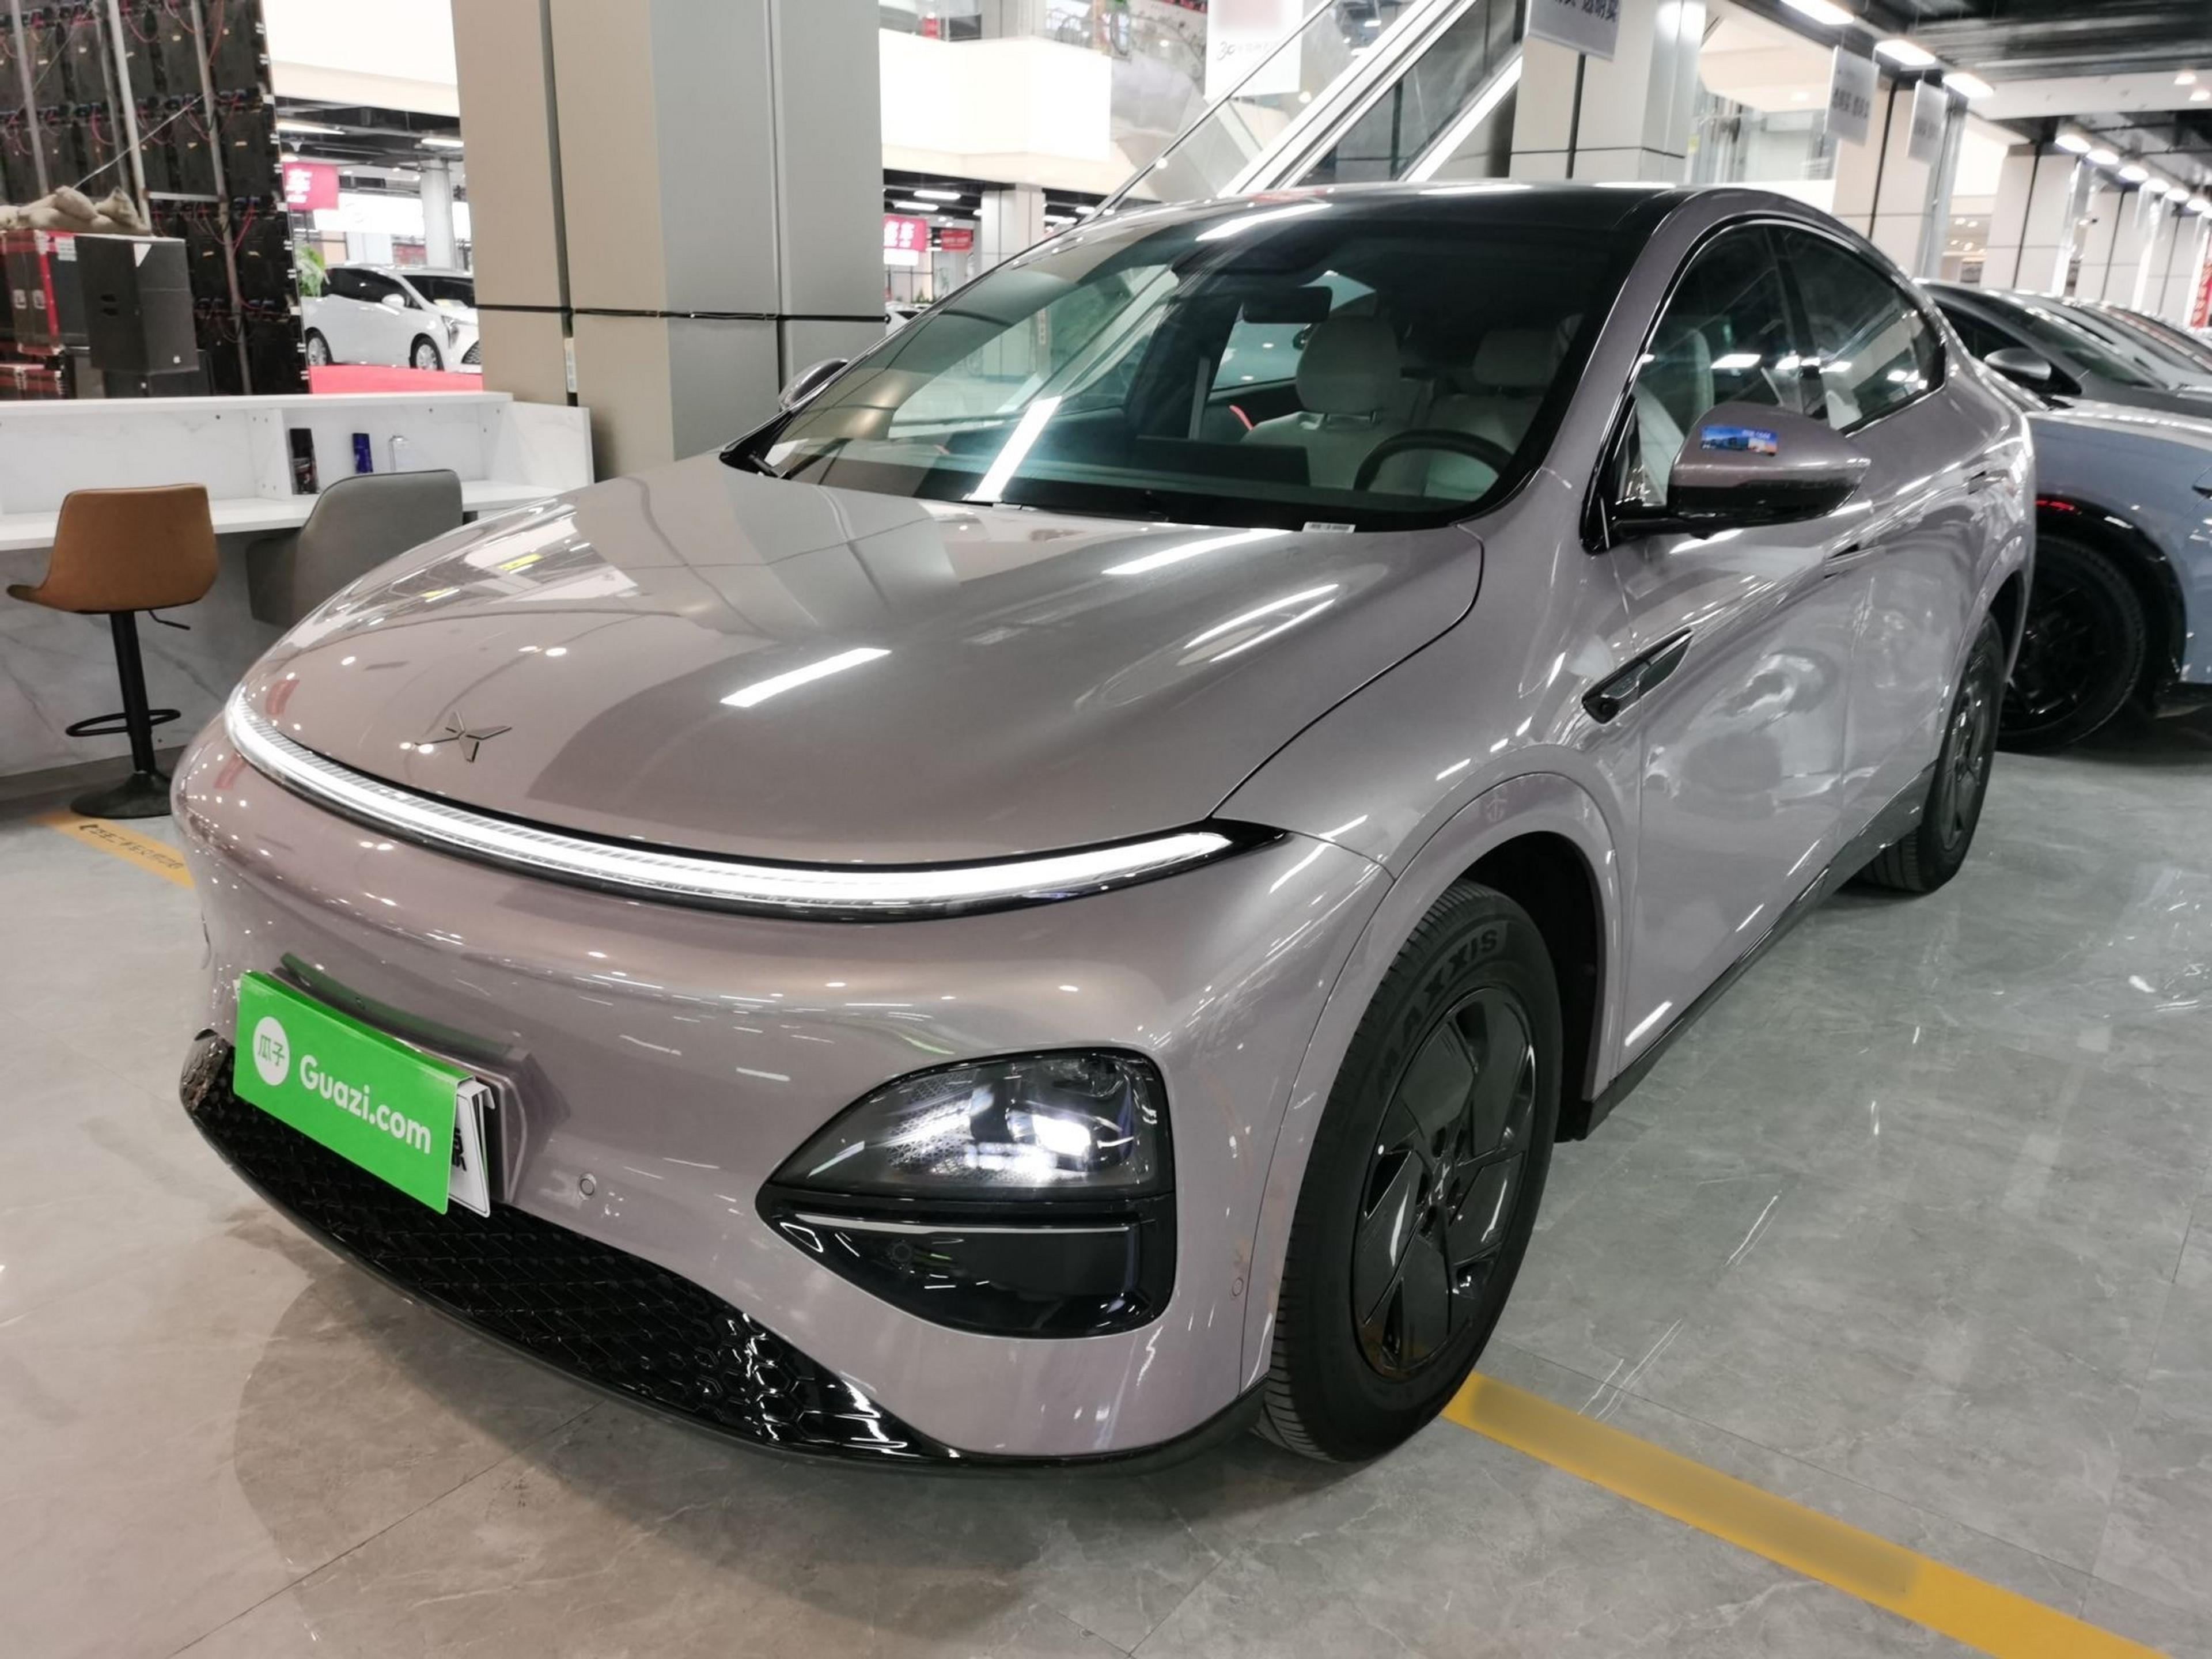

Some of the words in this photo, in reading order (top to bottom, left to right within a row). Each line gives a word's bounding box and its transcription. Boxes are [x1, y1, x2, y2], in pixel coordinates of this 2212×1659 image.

[257, 1034, 286, 1066] 瓜子
[1378, 929, 1498, 1100] MAXXIS
[300, 1054, 431, 1154] Guazi.com
